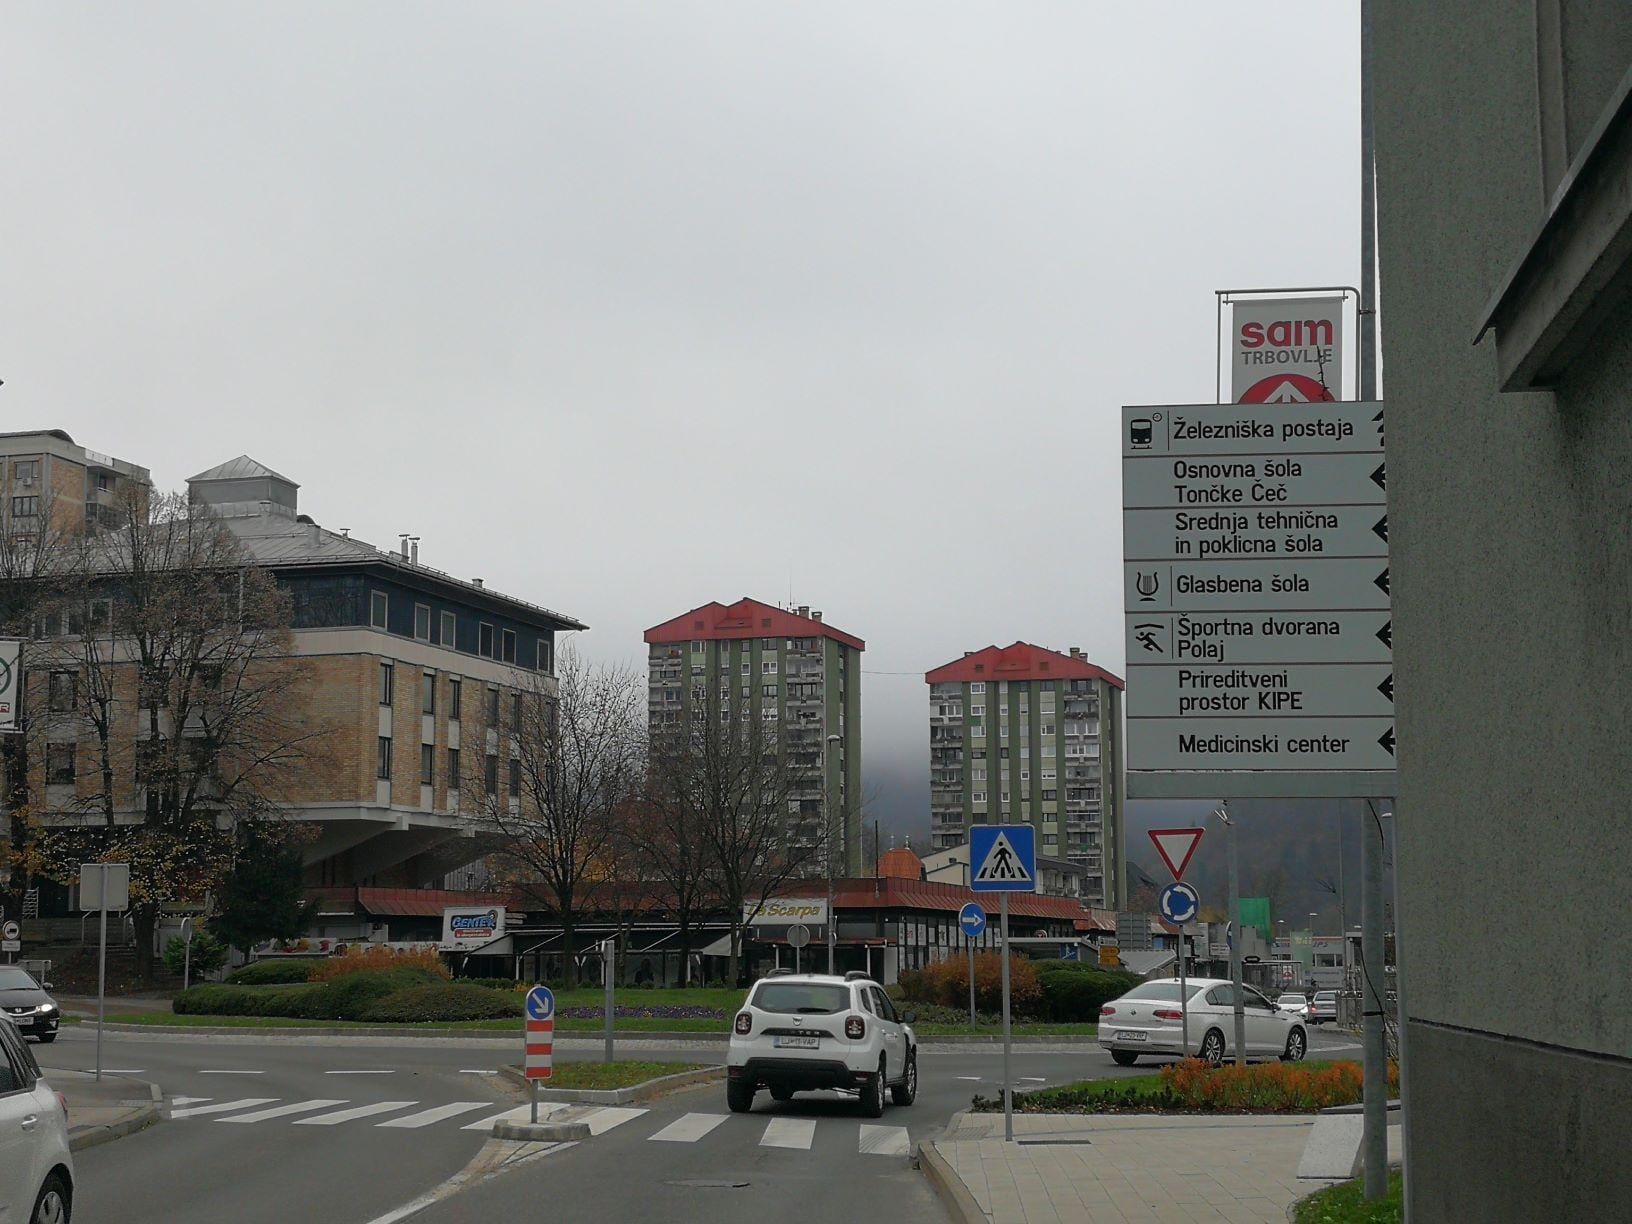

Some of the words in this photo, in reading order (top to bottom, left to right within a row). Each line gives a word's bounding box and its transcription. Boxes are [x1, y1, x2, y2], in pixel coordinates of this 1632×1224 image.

[1240, 319, 1333, 348] sam
[1173, 416, 1274, 441] Železniška
[1282, 418, 1354, 442] postaja
[1173, 460, 1256, 479] Osnovna
[1264, 458, 1302, 478] šola
[1174, 483, 1243, 503] Tončke
[1251, 479, 1288, 502] Čeč
[1175, 512, 1249, 534] Srednja
[1257, 510, 1339, 530] tehnična
[1175, 536, 1191, 554] in
[1199, 535, 1276, 558] poklicna
[1284, 534, 1323, 552] šola
[1176, 574, 1263, 593] Glasbena
[1271, 573, 1310, 592] šola
[1177, 612, 1254, 640] Športna
[1262, 617, 1340, 635] dvorana
[1178, 639, 1225, 662] Polaj
[1178, 669, 1288, 688] Prireditveni
[1178, 694, 1250, 714] prostor
[1258, 691, 1303, 711] KIPE
[1178, 734, 1279, 753] Medicinski
[1287, 736, 1350, 753] center
[768, 904, 821, 919] Scarpa
